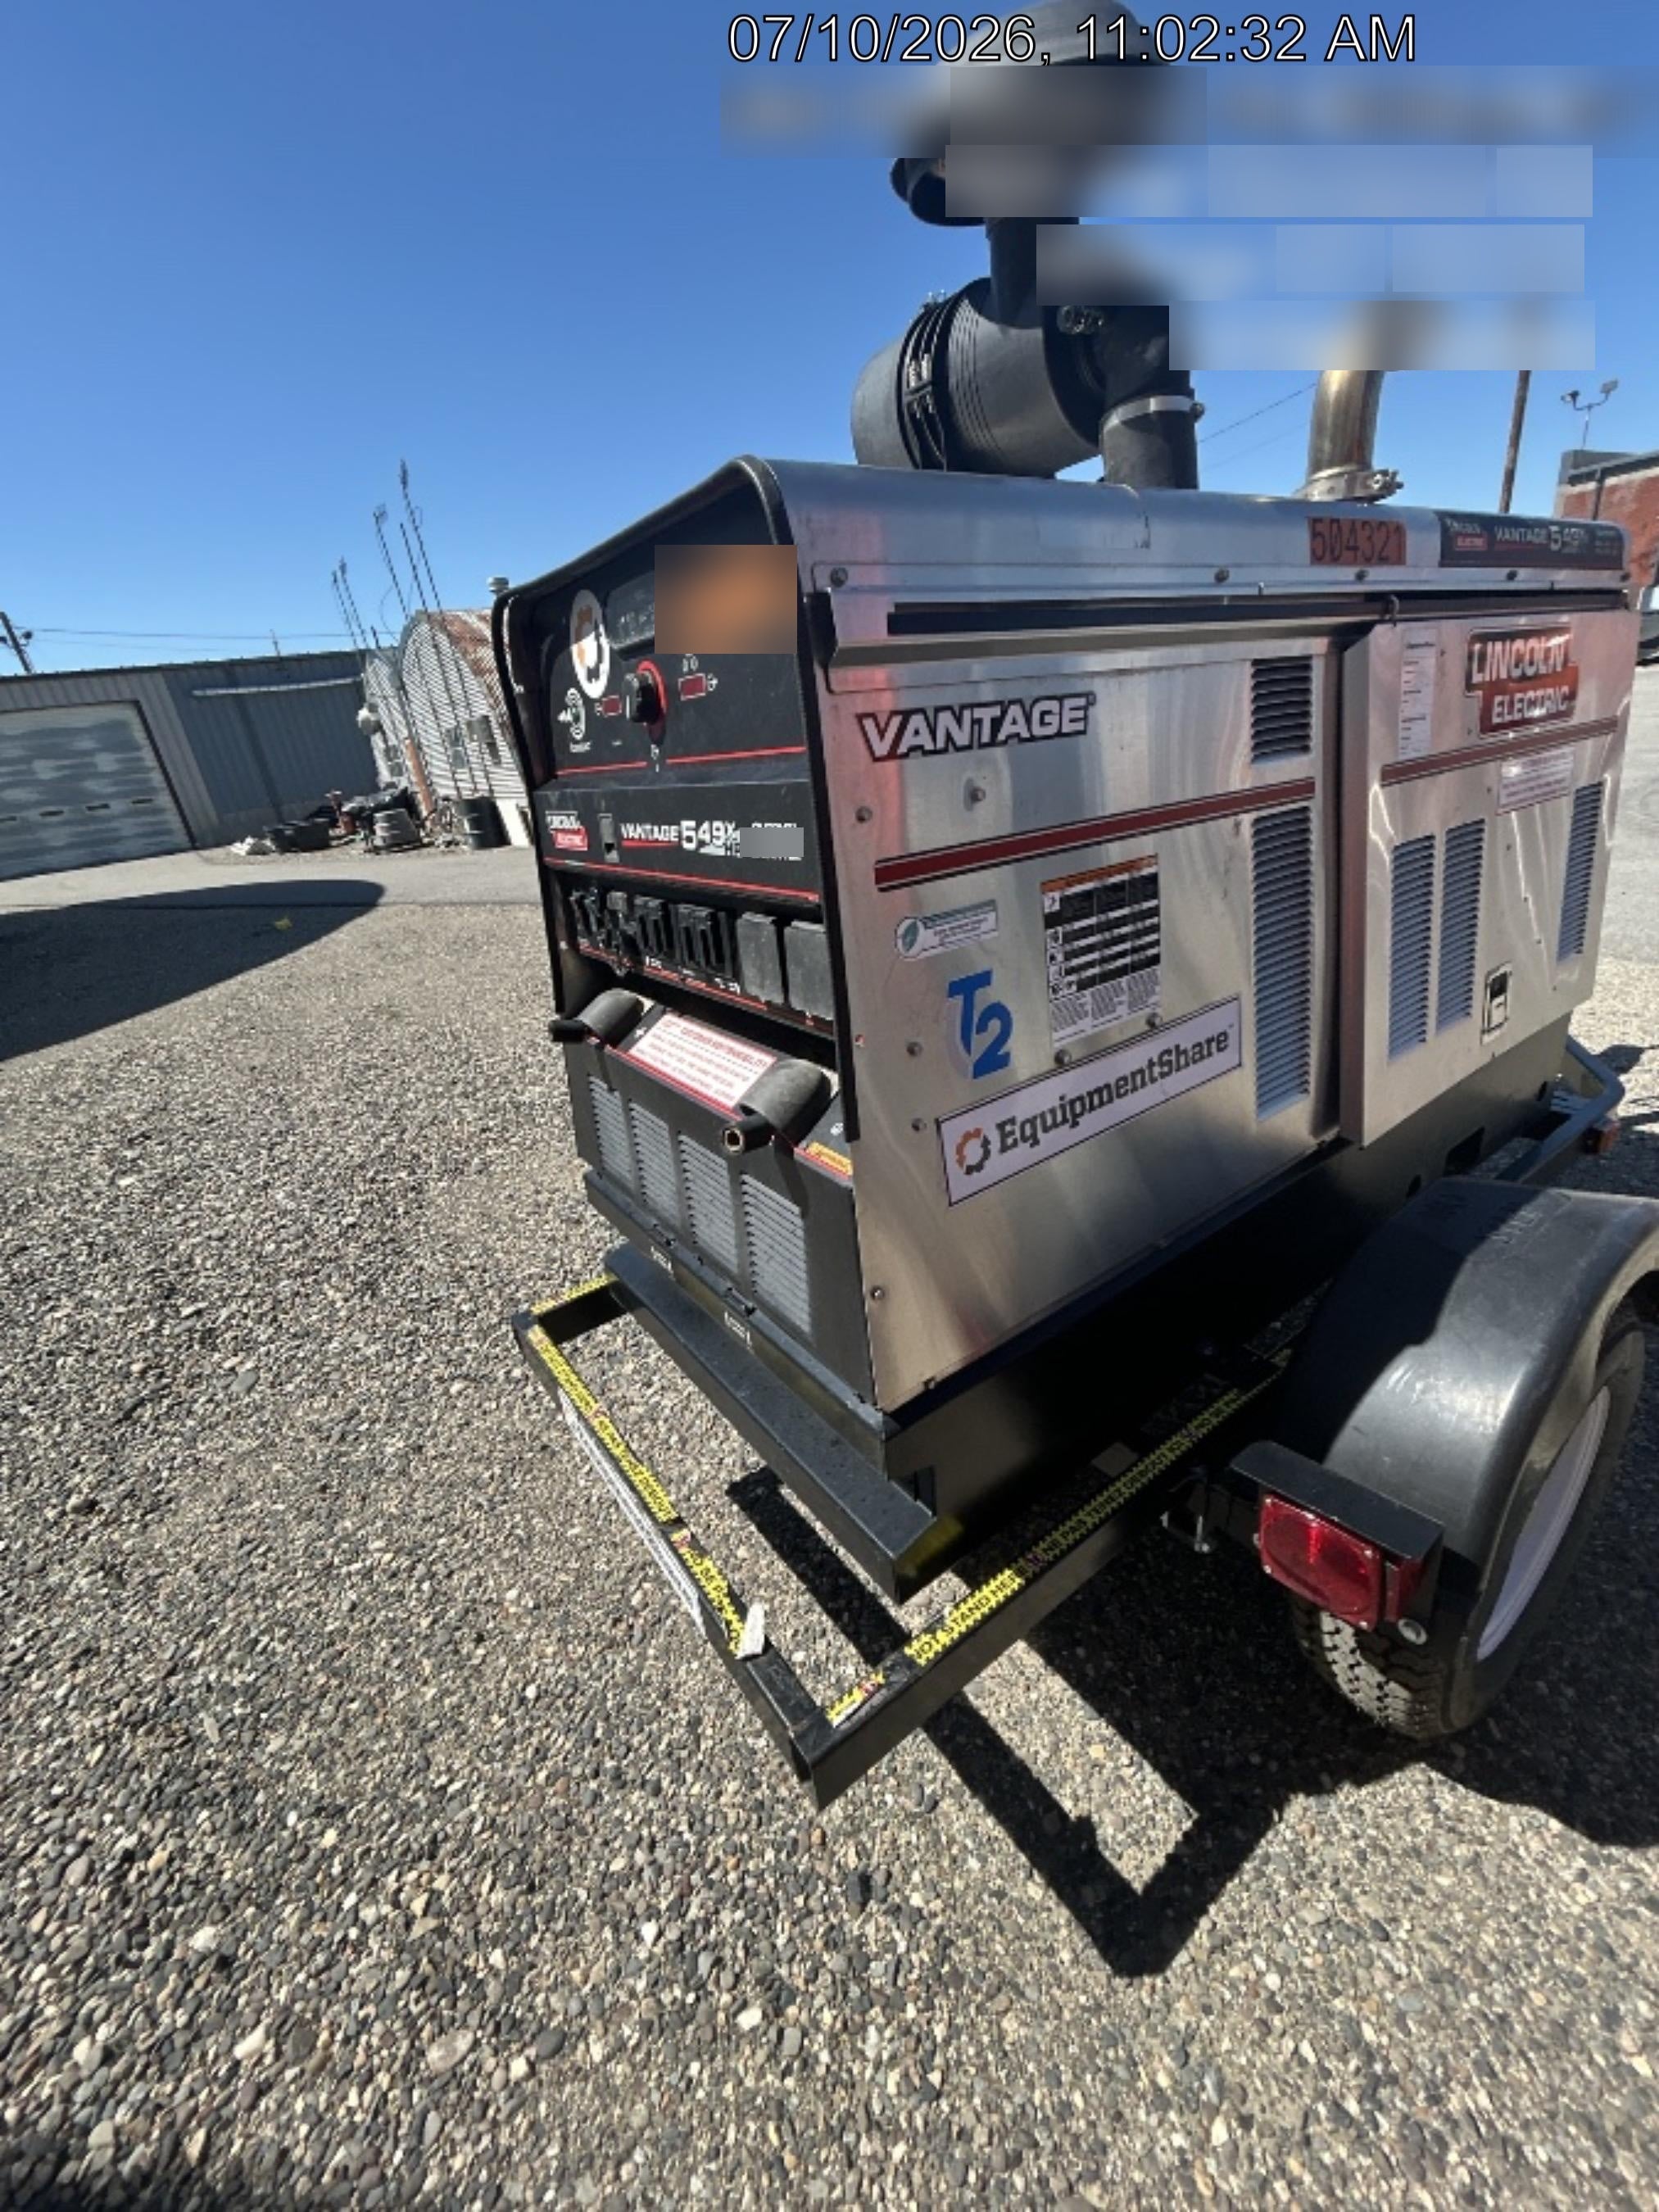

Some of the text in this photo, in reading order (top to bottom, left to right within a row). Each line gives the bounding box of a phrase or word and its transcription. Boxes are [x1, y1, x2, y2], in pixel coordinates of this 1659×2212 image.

[1311, 517, 1406, 563] 504321
[1471, 635, 1566, 684] LINCOLN
[856, 693, 1091, 762] VANTAGE
[1492, 685, 1570, 724] ELECTRIC
[620, 823, 679, 842] VANTAGE
[948, 968, 1013, 1079] T2
[995, 1029, 1229, 1154] EquipmentShare
